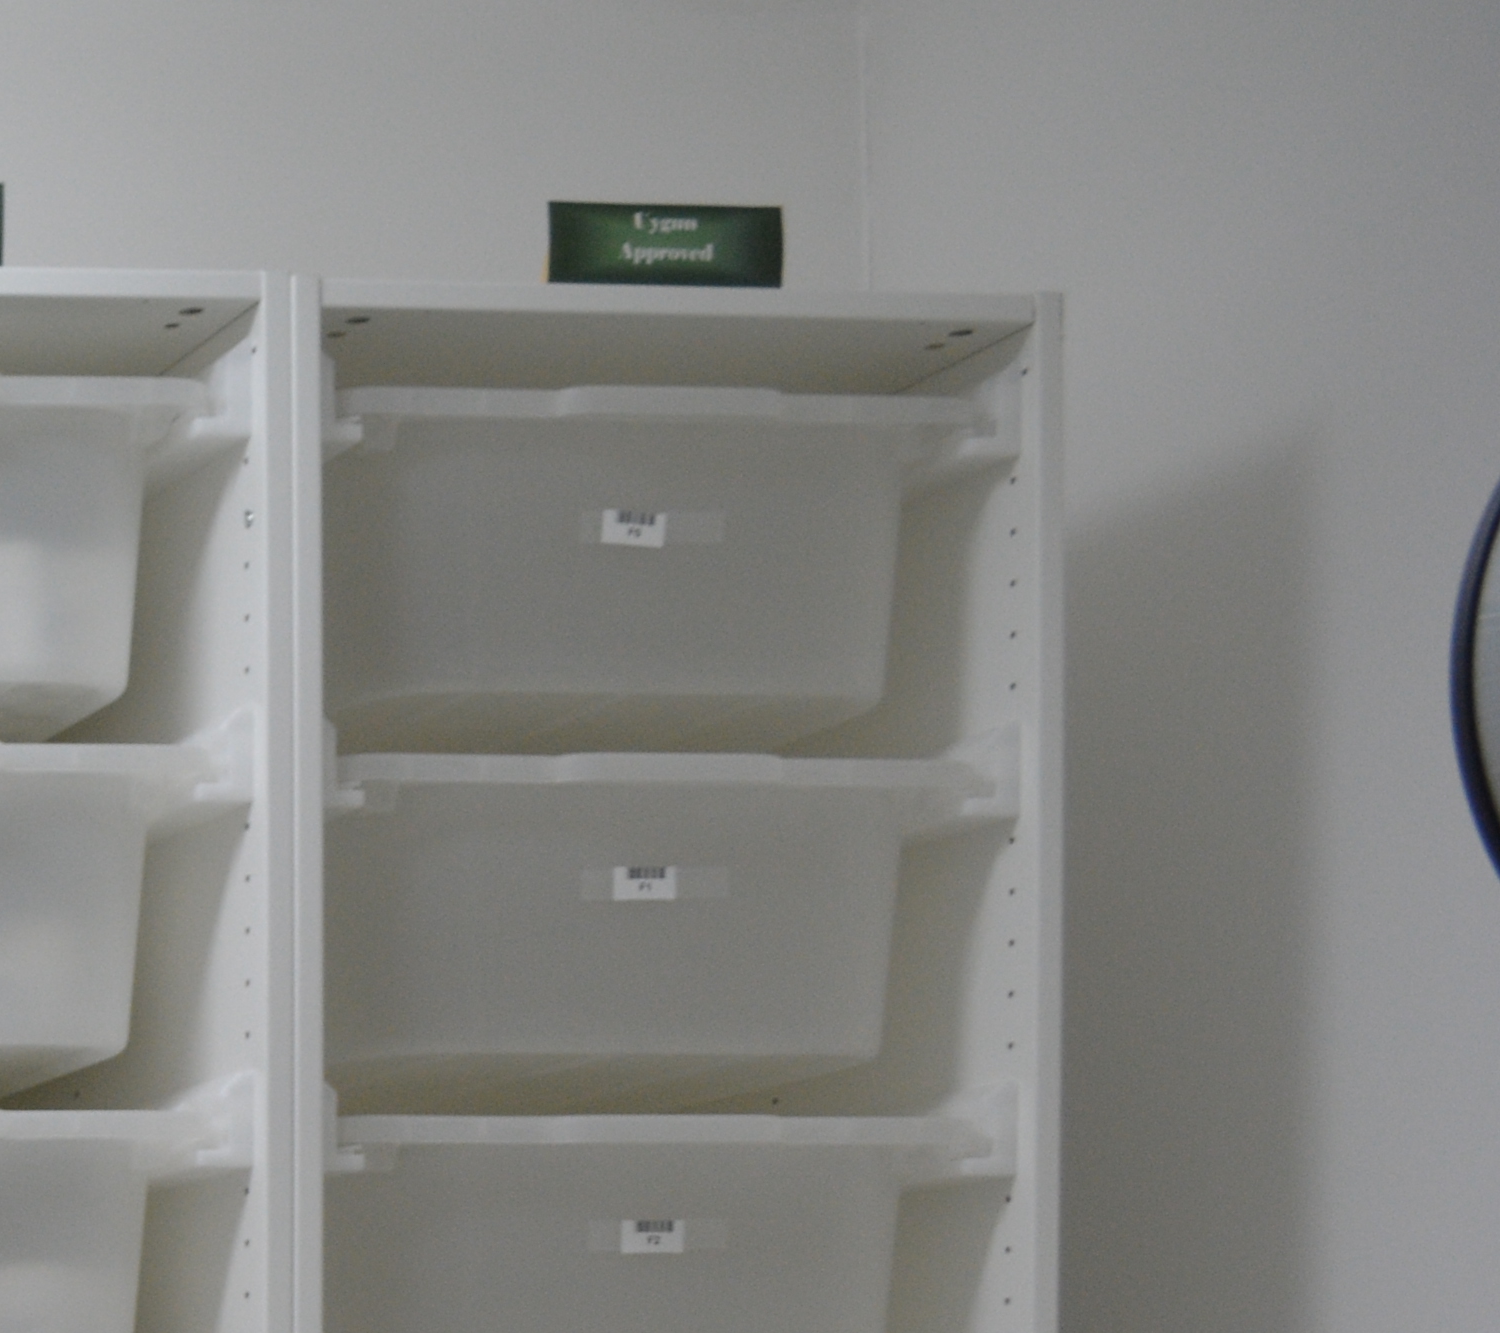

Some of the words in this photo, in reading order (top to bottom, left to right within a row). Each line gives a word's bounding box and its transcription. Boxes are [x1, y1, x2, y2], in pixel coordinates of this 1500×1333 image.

[633, 212, 698, 232] Uygun
[621, 242, 713, 264] Approved
[637, 880, 653, 892] F1
[646, 1234, 662, 1246] F2
